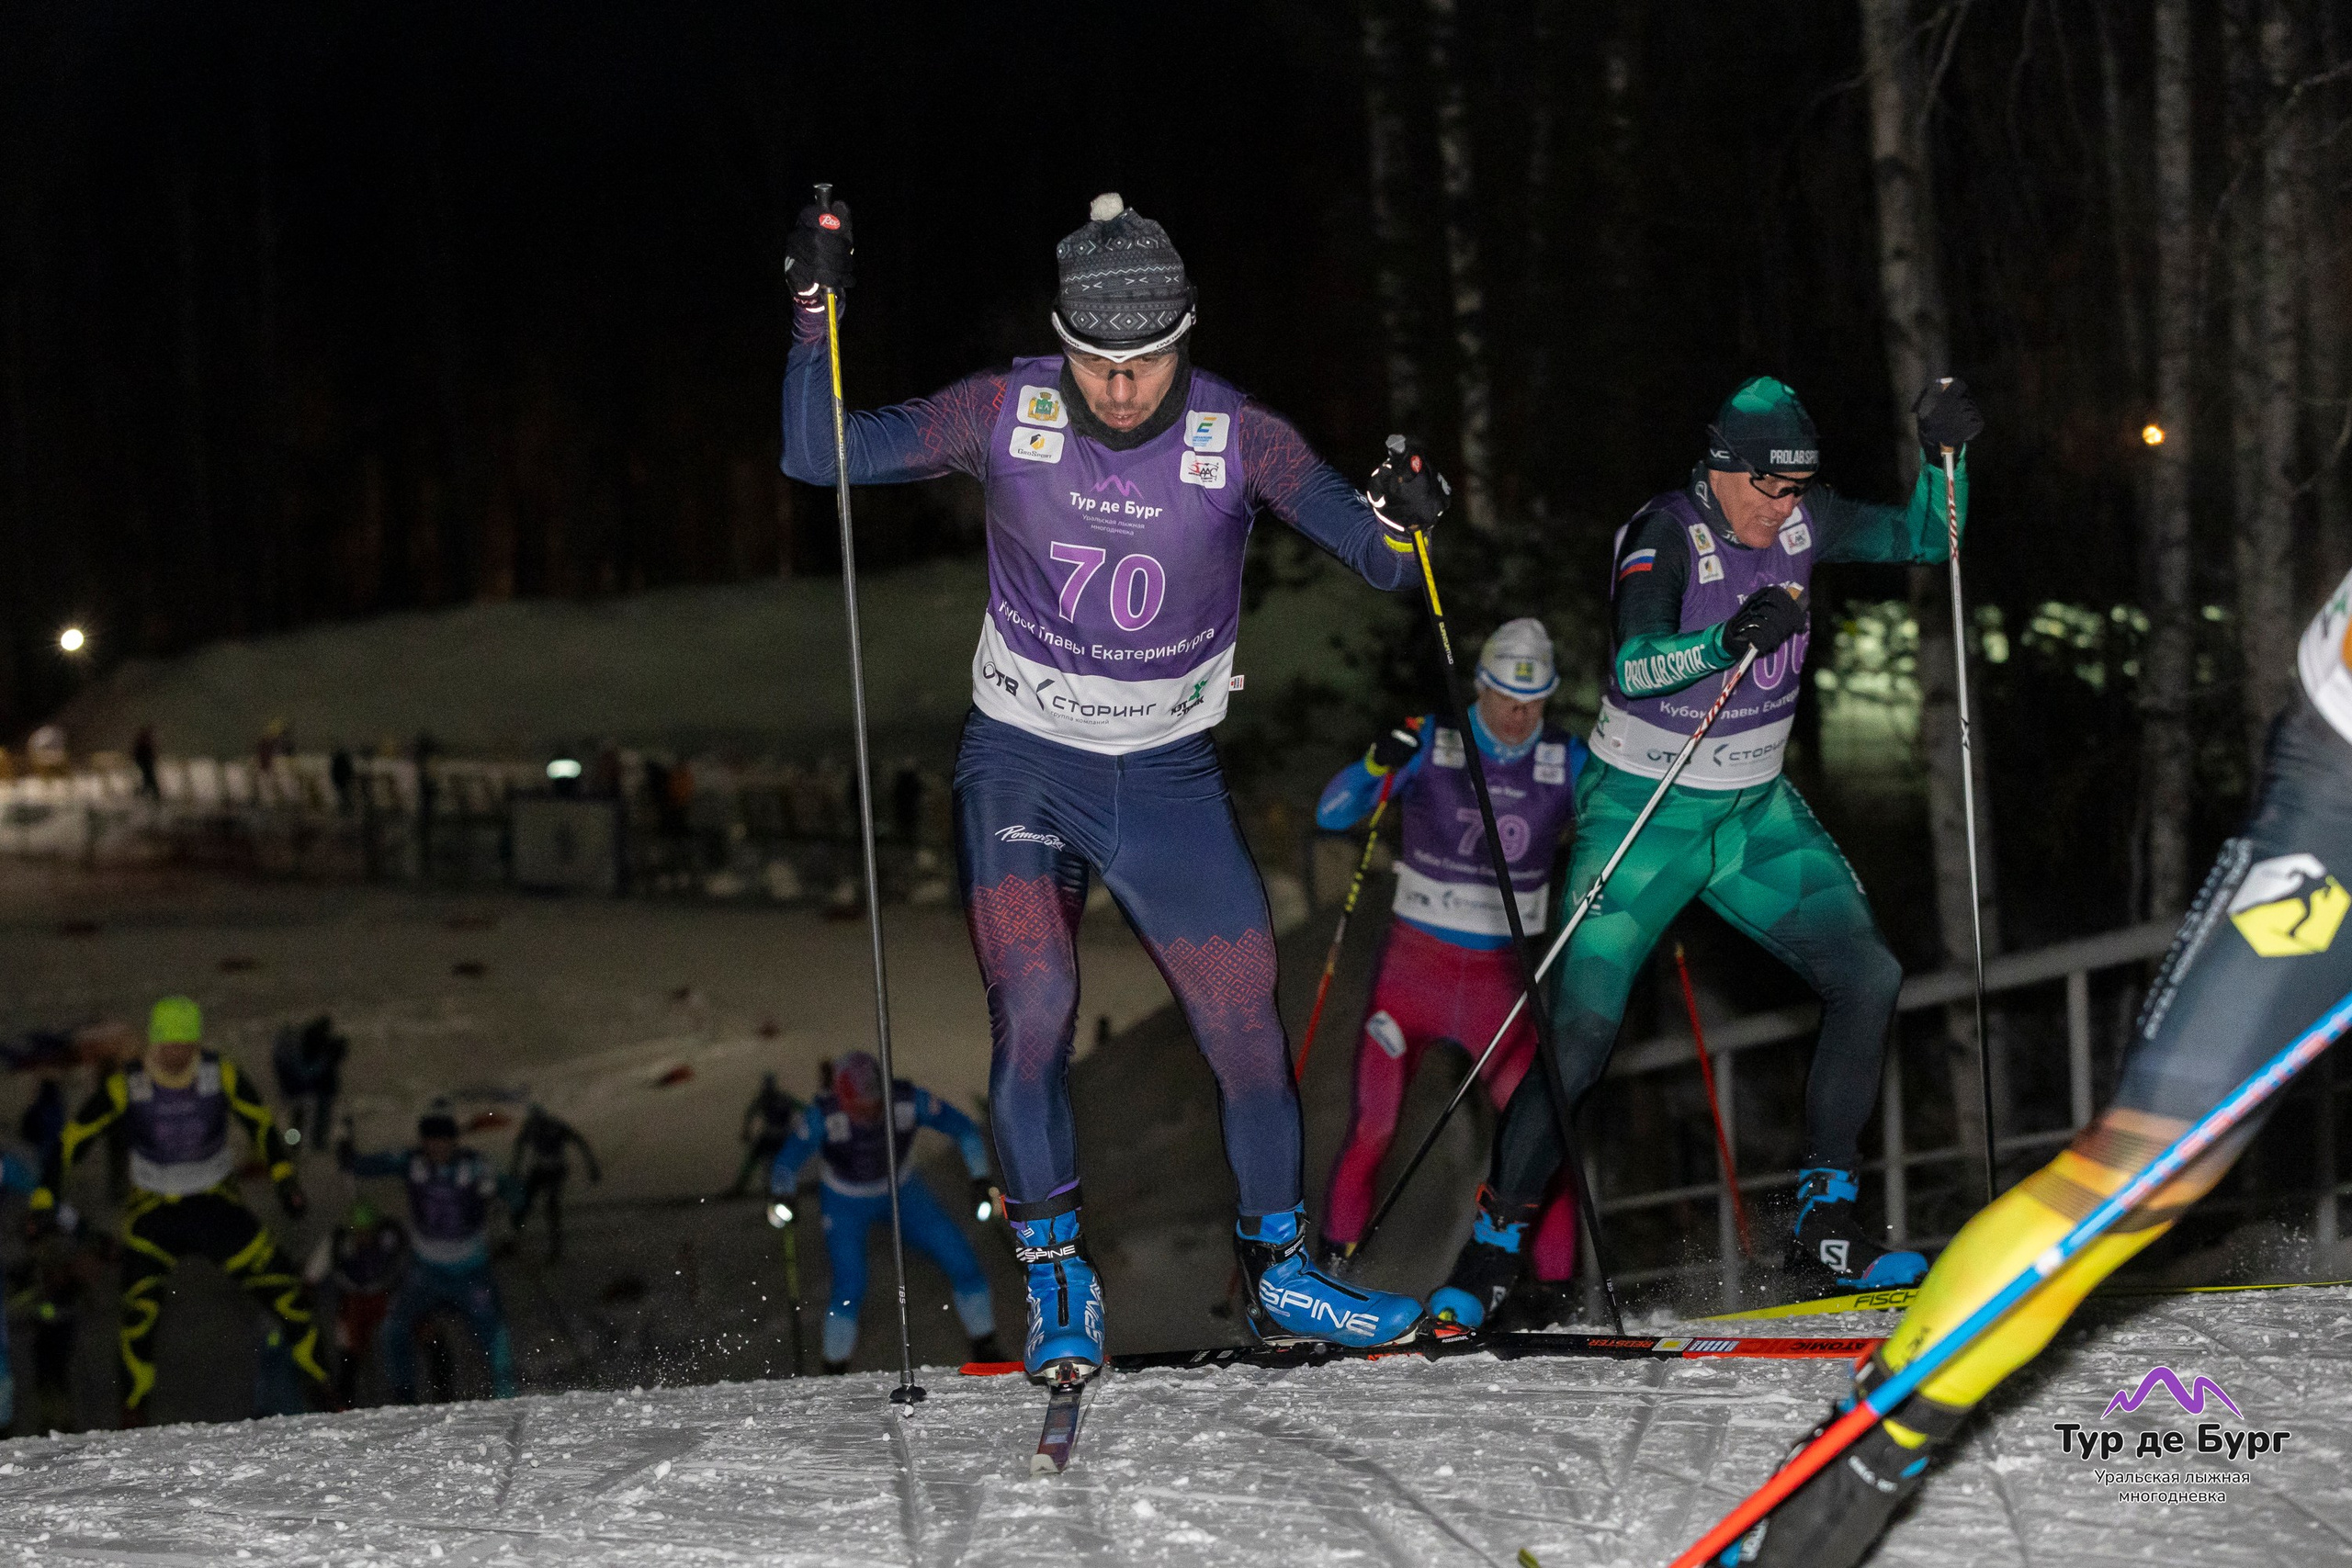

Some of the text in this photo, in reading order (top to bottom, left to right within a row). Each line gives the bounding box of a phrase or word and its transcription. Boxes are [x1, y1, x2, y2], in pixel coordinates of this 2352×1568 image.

[1069, 491, 1163, 519] Тур де Бург
[1082, 514, 1116, 525] Уральская
[1050, 541, 1165, 631] 70
[999, 599, 1215, 662] Кубок Главы Екатеринбурга
[1052, 695, 1157, 717] СТОРИНГ
[1720, 705, 1759, 720] лавы
[1050, 711, 1109, 725] группа компаний
[1024, 1245, 1076, 1260] SPINE
[1259, 1278, 1379, 1337] SPINE
[1853, 1291, 1918, 1308] FISCH
[1589, 1339, 1654, 1348] REDSTER
[1790, 1340, 1866, 1351] ATOMIC
